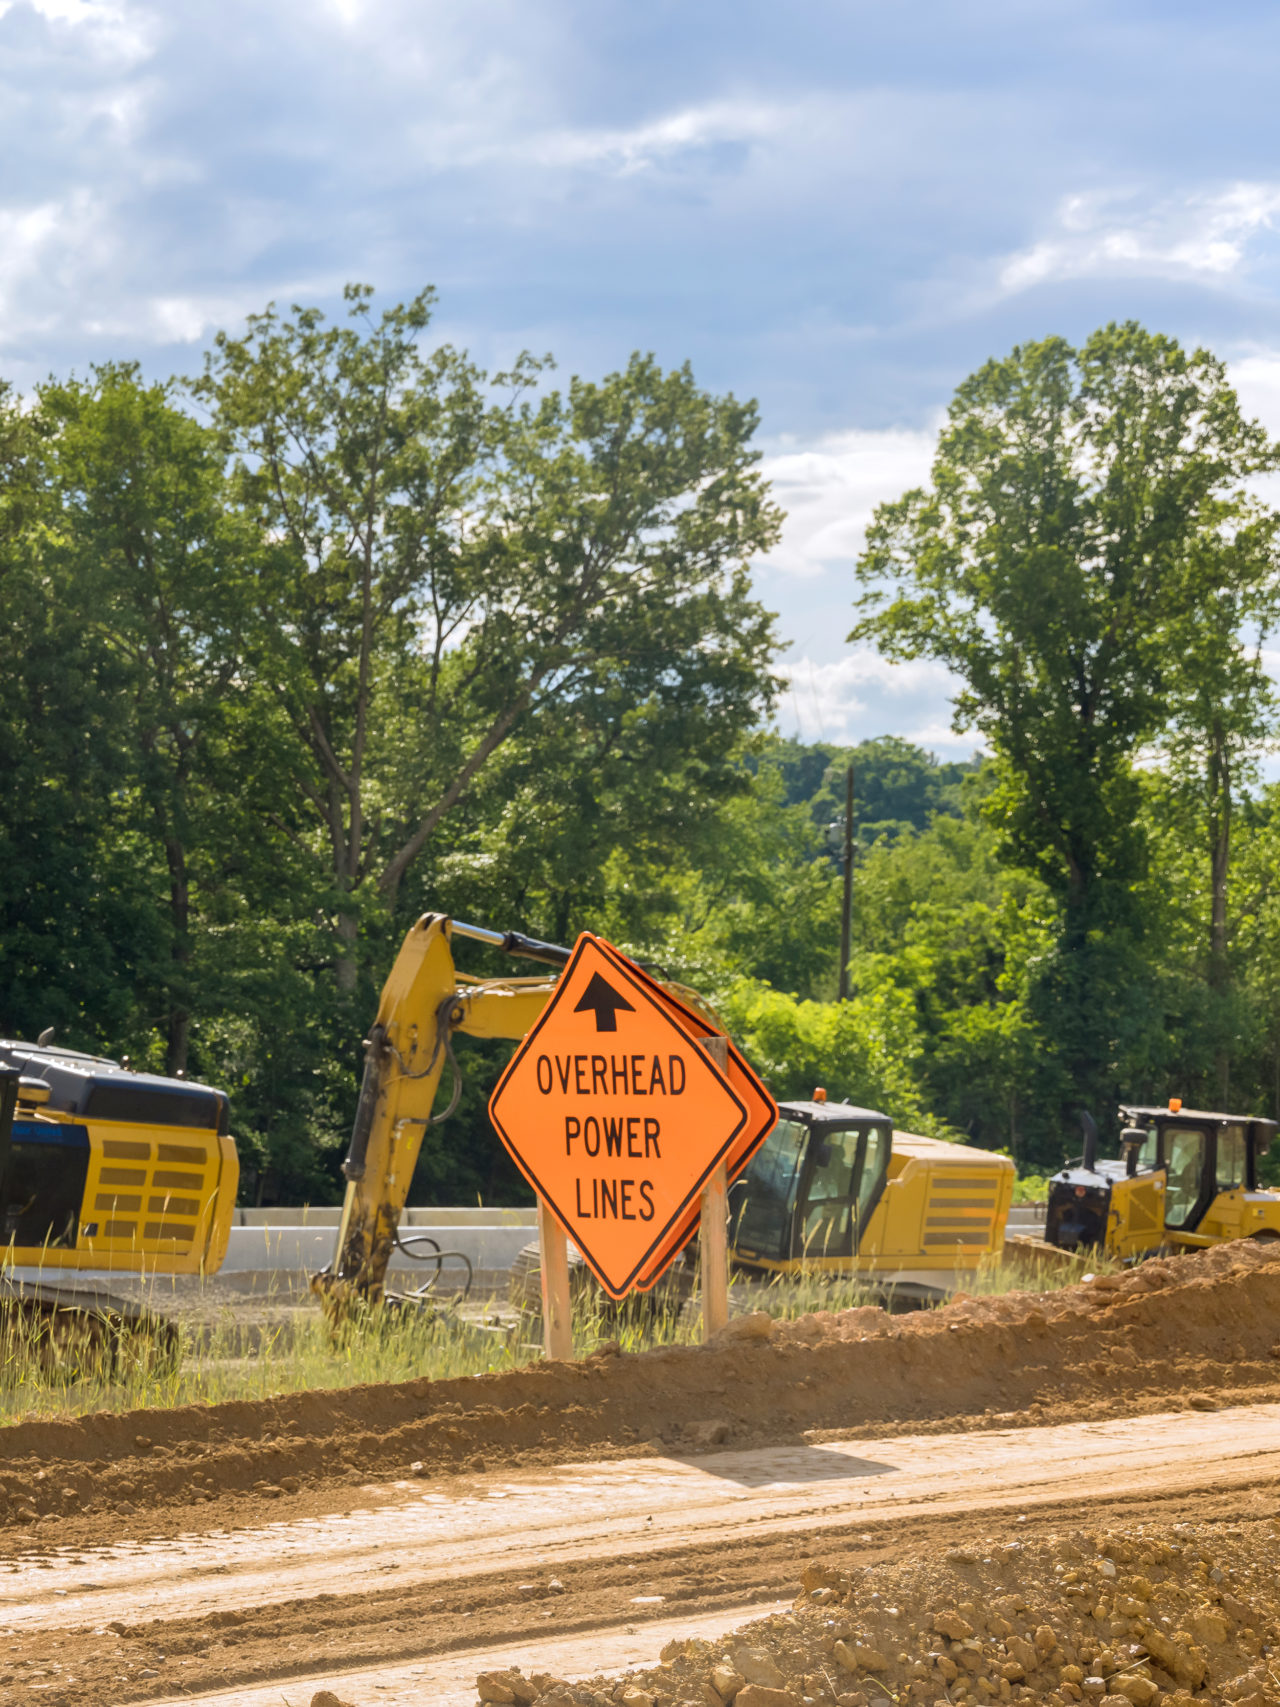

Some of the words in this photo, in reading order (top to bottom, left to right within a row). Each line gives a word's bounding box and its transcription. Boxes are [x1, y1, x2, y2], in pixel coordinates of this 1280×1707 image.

[536, 1054, 686, 1096] OVERHEAD
[565, 1116, 661, 1159] POWER
[576, 1178, 655, 1222] LINES
